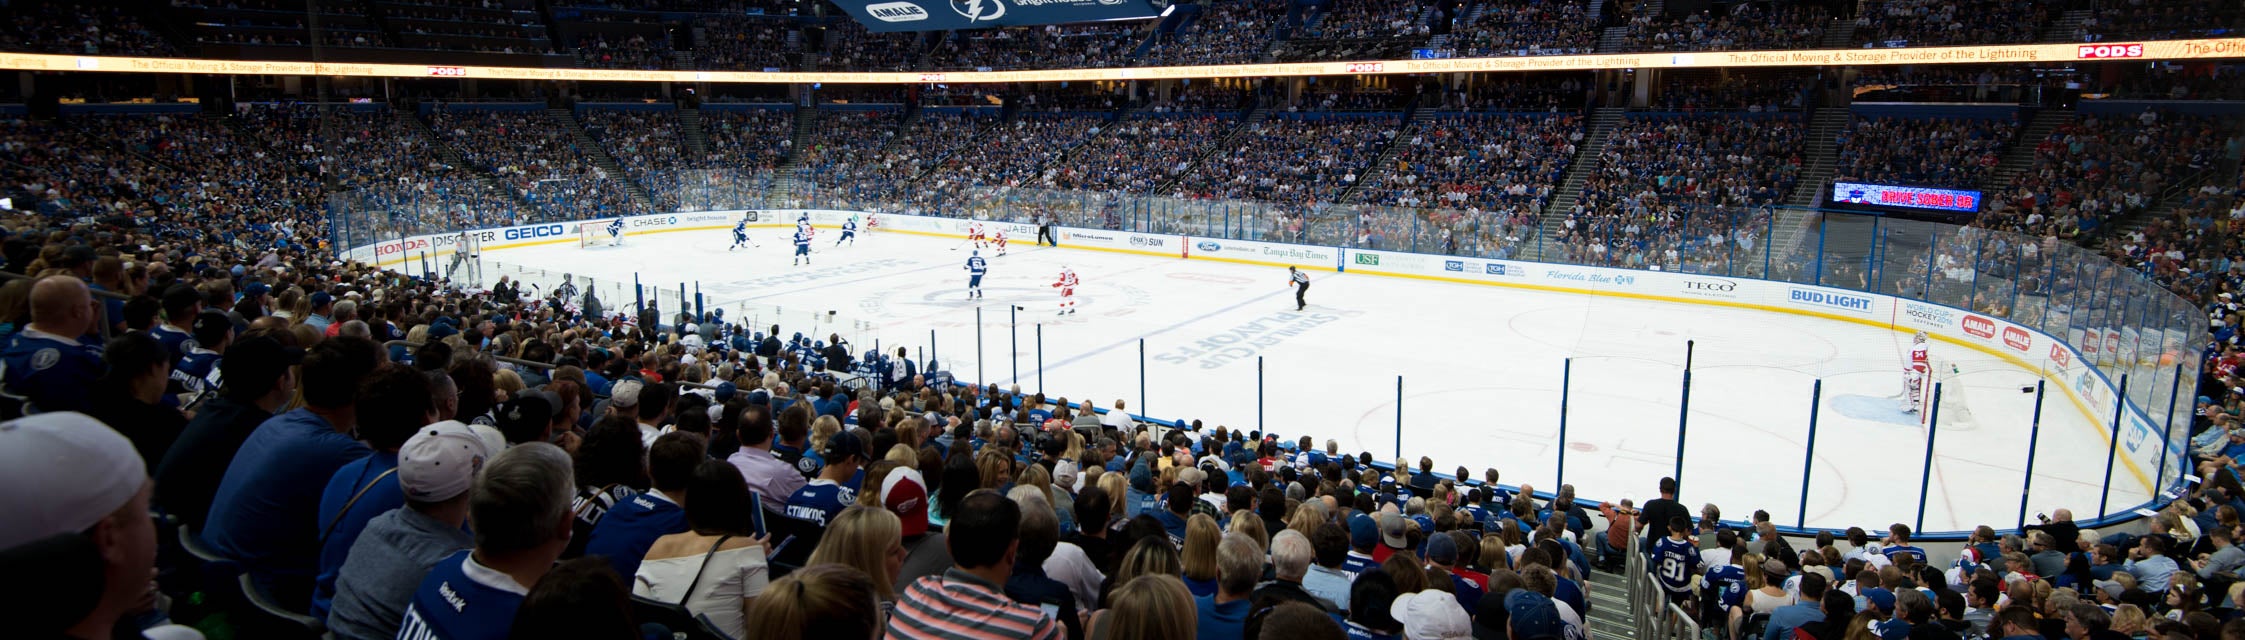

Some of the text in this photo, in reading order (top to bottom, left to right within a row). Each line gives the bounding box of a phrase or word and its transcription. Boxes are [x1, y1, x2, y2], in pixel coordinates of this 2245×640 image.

[873, 5, 923, 18] AMALIE
[2079, 45, 2142, 58] PODS
[2185, 43, 2210, 54] The
[1728, 54, 1747, 62] The
[1750, 53, 1788, 62] Official
[1792, 53, 1830, 63] Moving
[1846, 52, 1887, 64] Storage
[1890, 50, 1936, 60] Provider
[1956, 49, 1974, 59] the
[1979, 48, 2037, 60] Lightning
[132, 59, 148, 68] The
[151, 60, 184, 70] Official
[187, 61, 219, 72] Moving
[230, 63, 262, 73] Storage
[266, 63, 302, 72] Provider
[334, 65, 373, 75] Lightning
[1347, 63, 1382, 72] PODS
[1407, 62, 1421, 70] The
[1423, 61, 1450, 70] Official
[1454, 60, 1482, 69] Moving
[1494, 59, 1525, 69] Storage
[1528, 58, 1563, 67] Provider
[1577, 57, 1592, 66] the
[1596, 57, 1640, 67] Lightning
[429, 67, 464, 77] PODS
[1881, 190, 1913, 204] DRIVE
[1916, 192, 1953, 207] SOBER
[633, 217, 666, 227] CHASE
[505, 224, 564, 240] GEICO
[1005, 224, 1039, 235] JABIL
[436, 231, 495, 247] DISCER
[1148, 238, 1164, 247] SUN
[376, 239, 429, 256] HONDA
[1263, 246, 1288, 258] Tampa
[1290, 248, 1304, 259] Bay
[1305, 249, 1328, 260] Times
[1357, 253, 1379, 264] USF
[1546, 270, 1611, 284] Florida Blue
[1683, 280, 1735, 292] TECO
[1791, 290, 1870, 310] BUD LIGHT
[1906, 303, 1934, 314] WORLD
[1934, 308, 1950, 317] CUP
[1906, 310, 1953, 326] HOCKEY 2016
[1964, 318, 1994, 333] AMALIE
[1153, 311, 1304, 365] PLAYOFFS
[2004, 329, 2030, 346] AMALIE
[1199, 346, 1256, 370] CUP
[1661, 558, 1686, 582] 91
